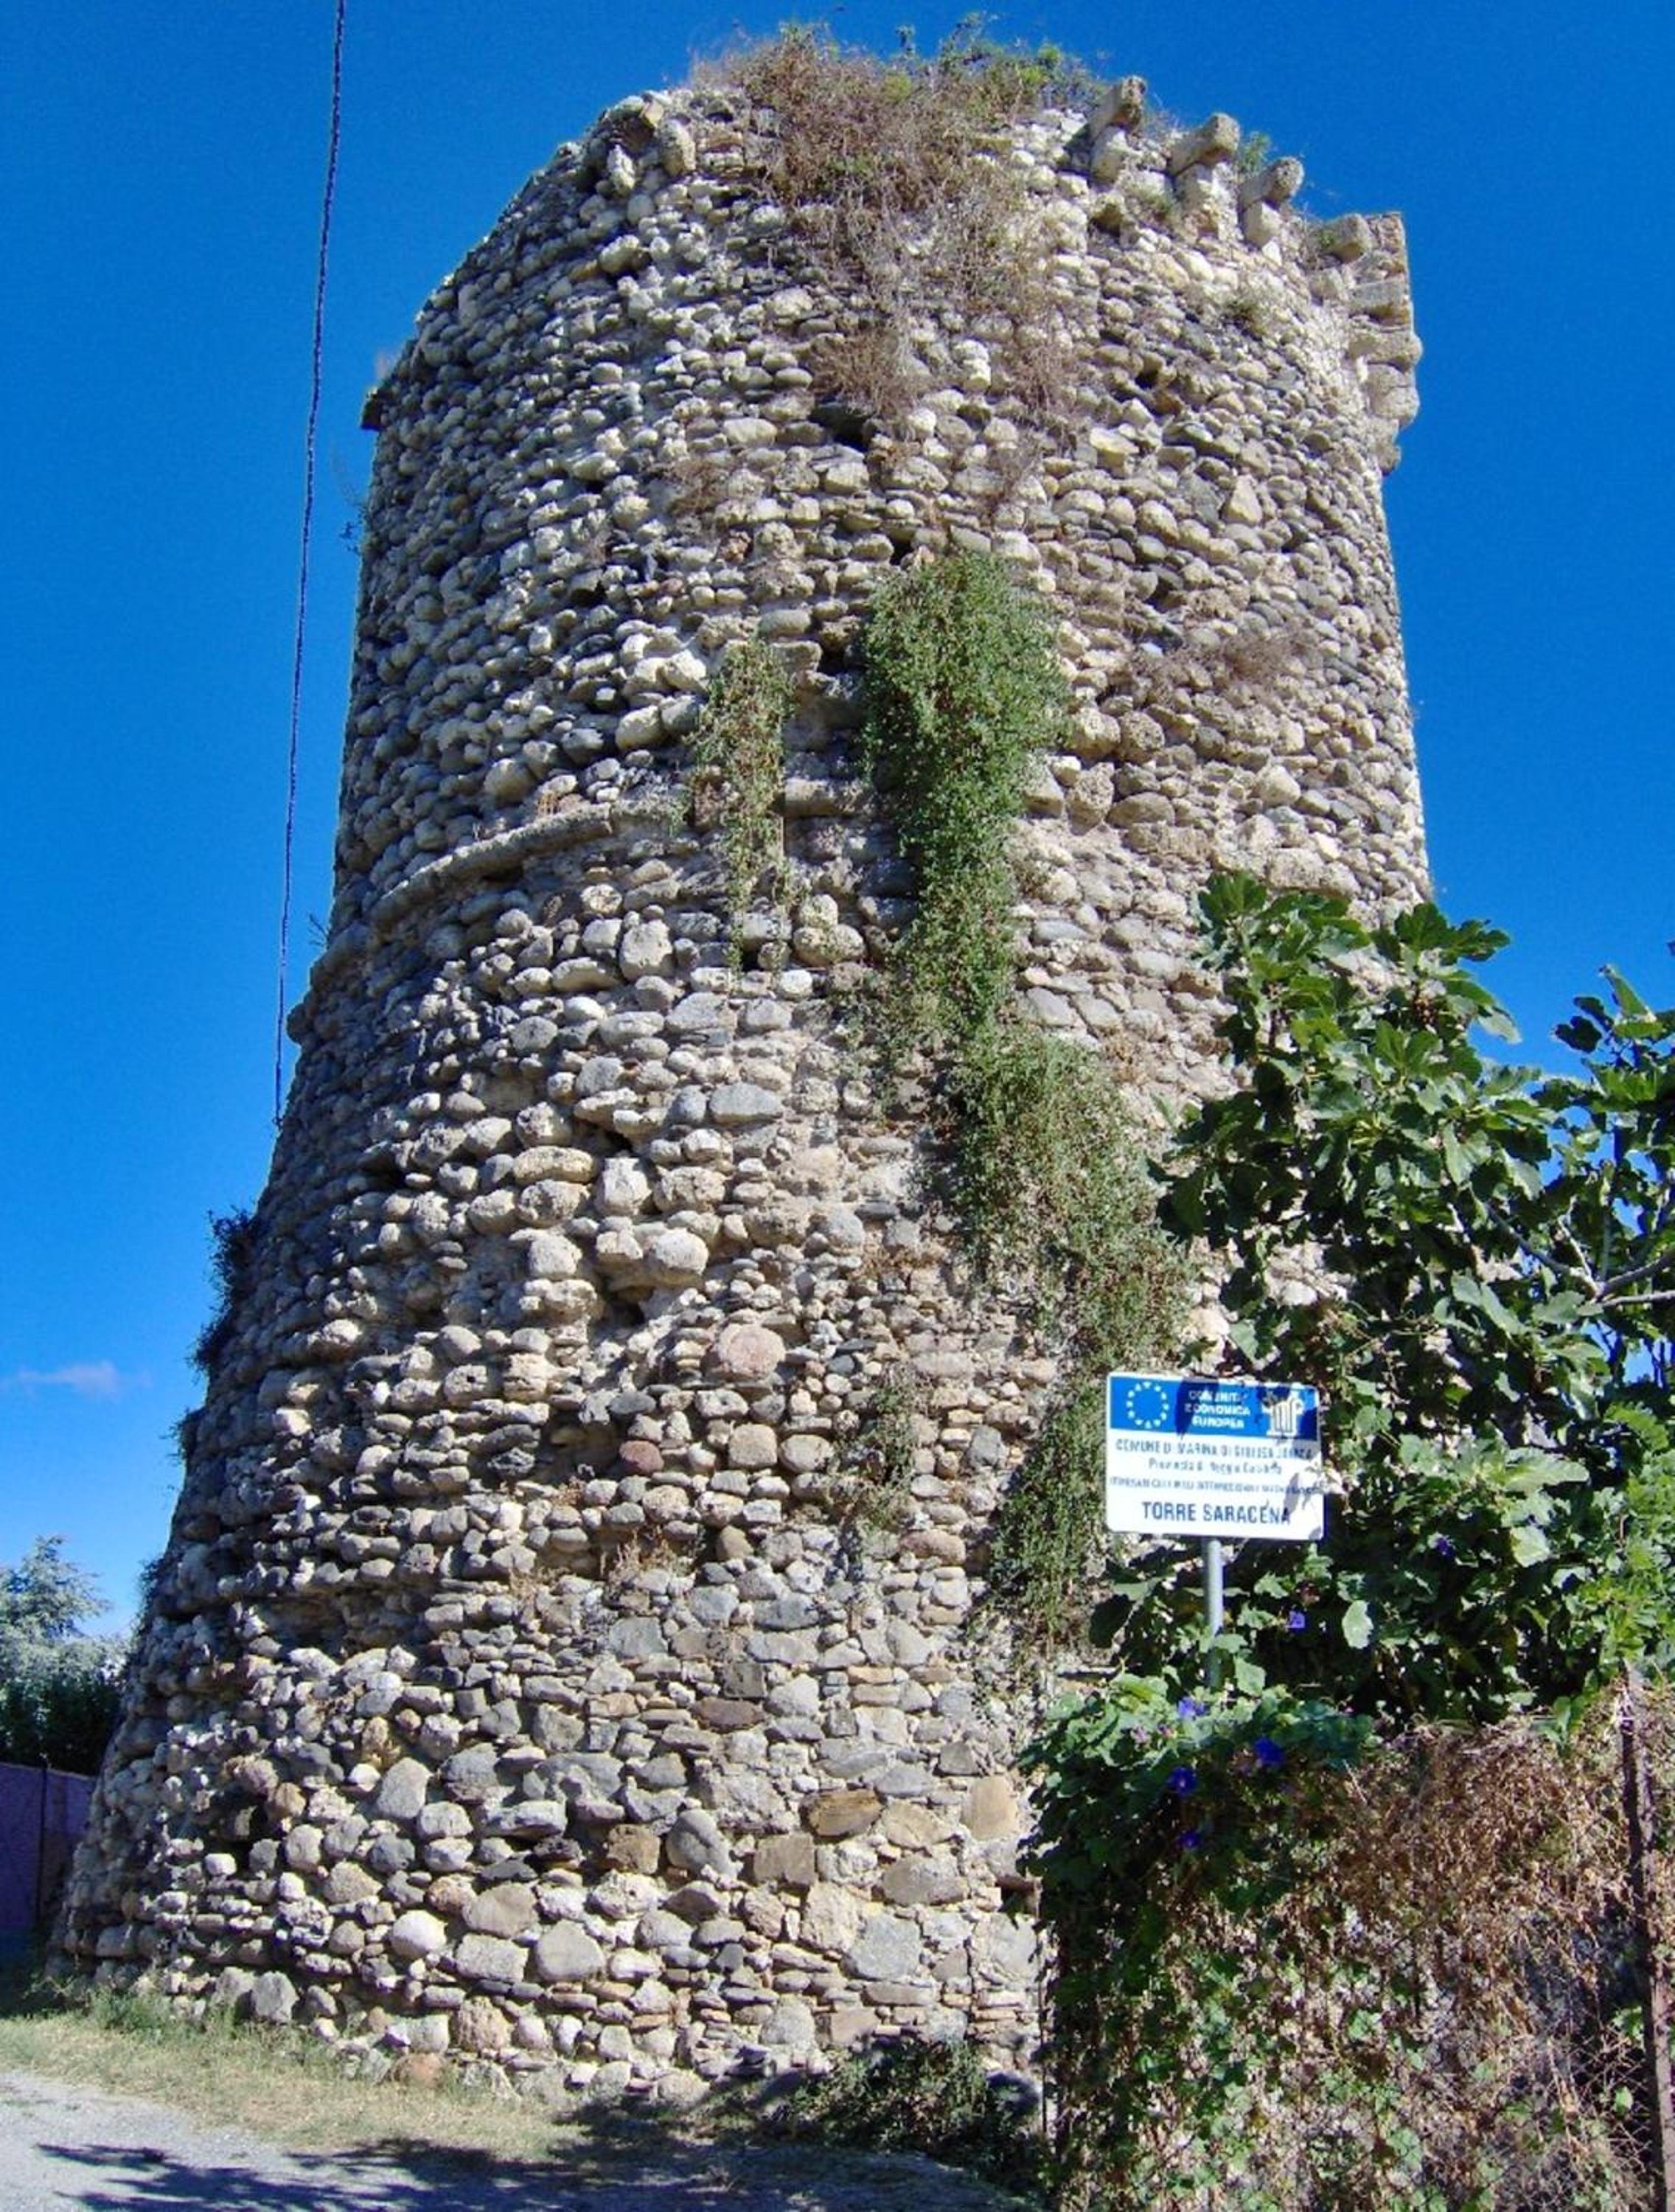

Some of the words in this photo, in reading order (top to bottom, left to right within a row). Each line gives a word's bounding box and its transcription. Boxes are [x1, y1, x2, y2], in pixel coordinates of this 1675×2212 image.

[1191, 1413, 1245, 1429] EUROPEA
[1142, 1501, 1197, 1521] TORRE
[1203, 1503, 1291, 1525] SARACENA
